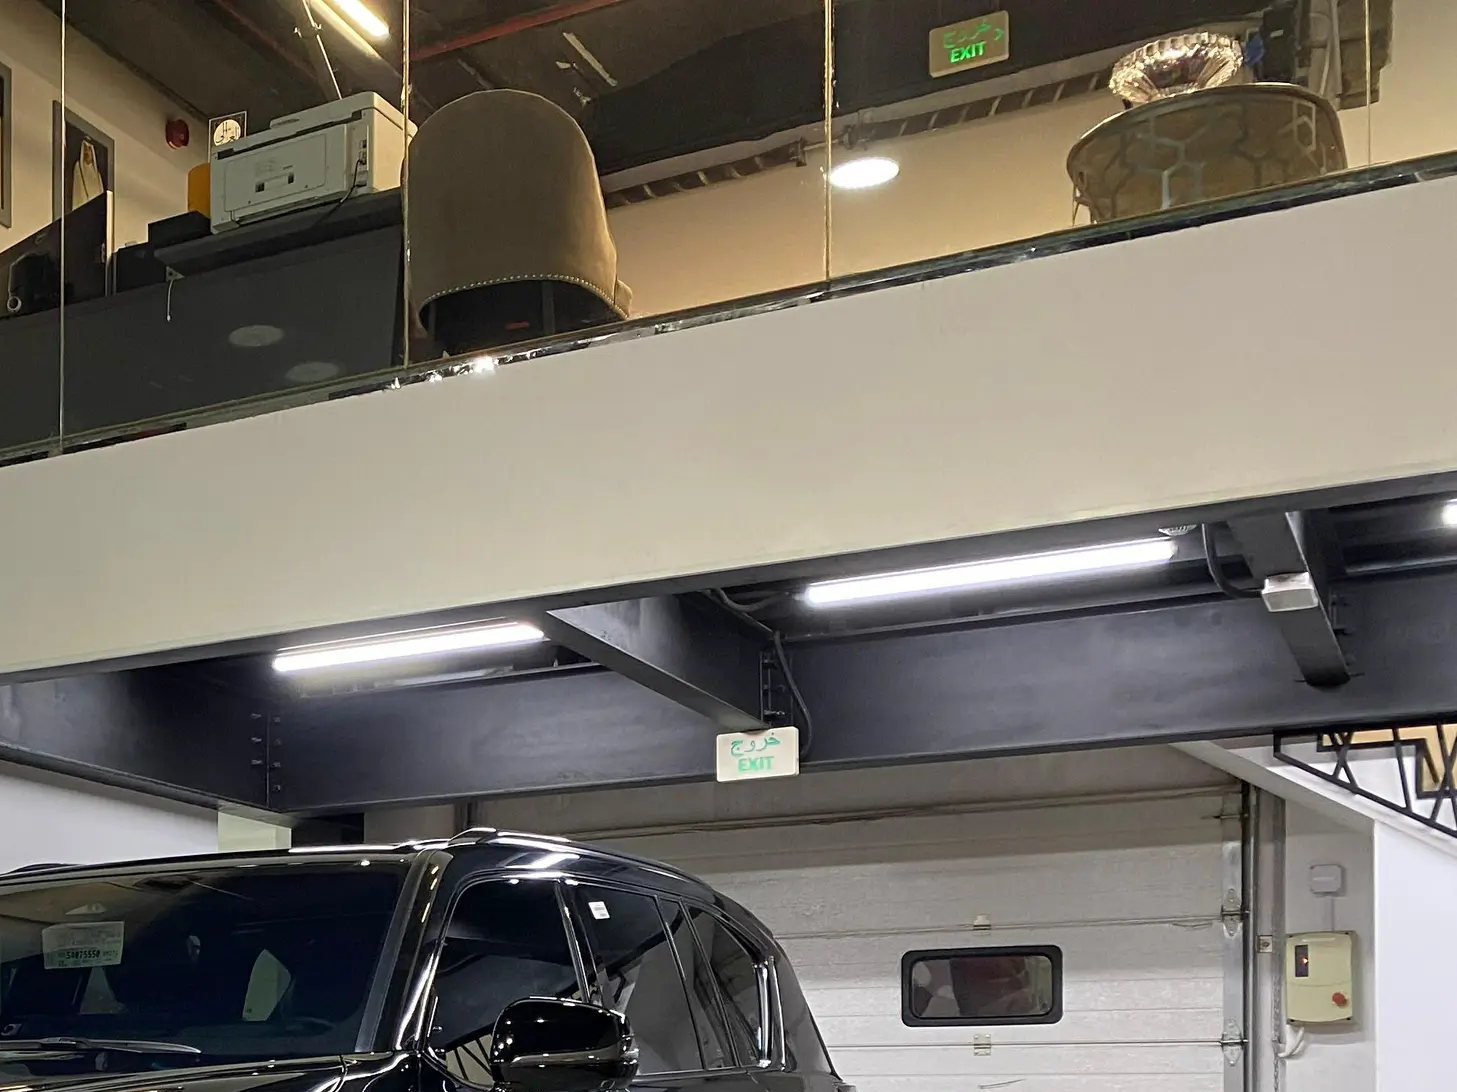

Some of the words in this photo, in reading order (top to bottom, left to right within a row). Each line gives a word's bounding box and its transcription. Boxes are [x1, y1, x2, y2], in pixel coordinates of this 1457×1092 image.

[949, 41, 986, 63] EXIT
[730, 732, 781, 756] خروج
[737, 756, 775, 772] EXIT
